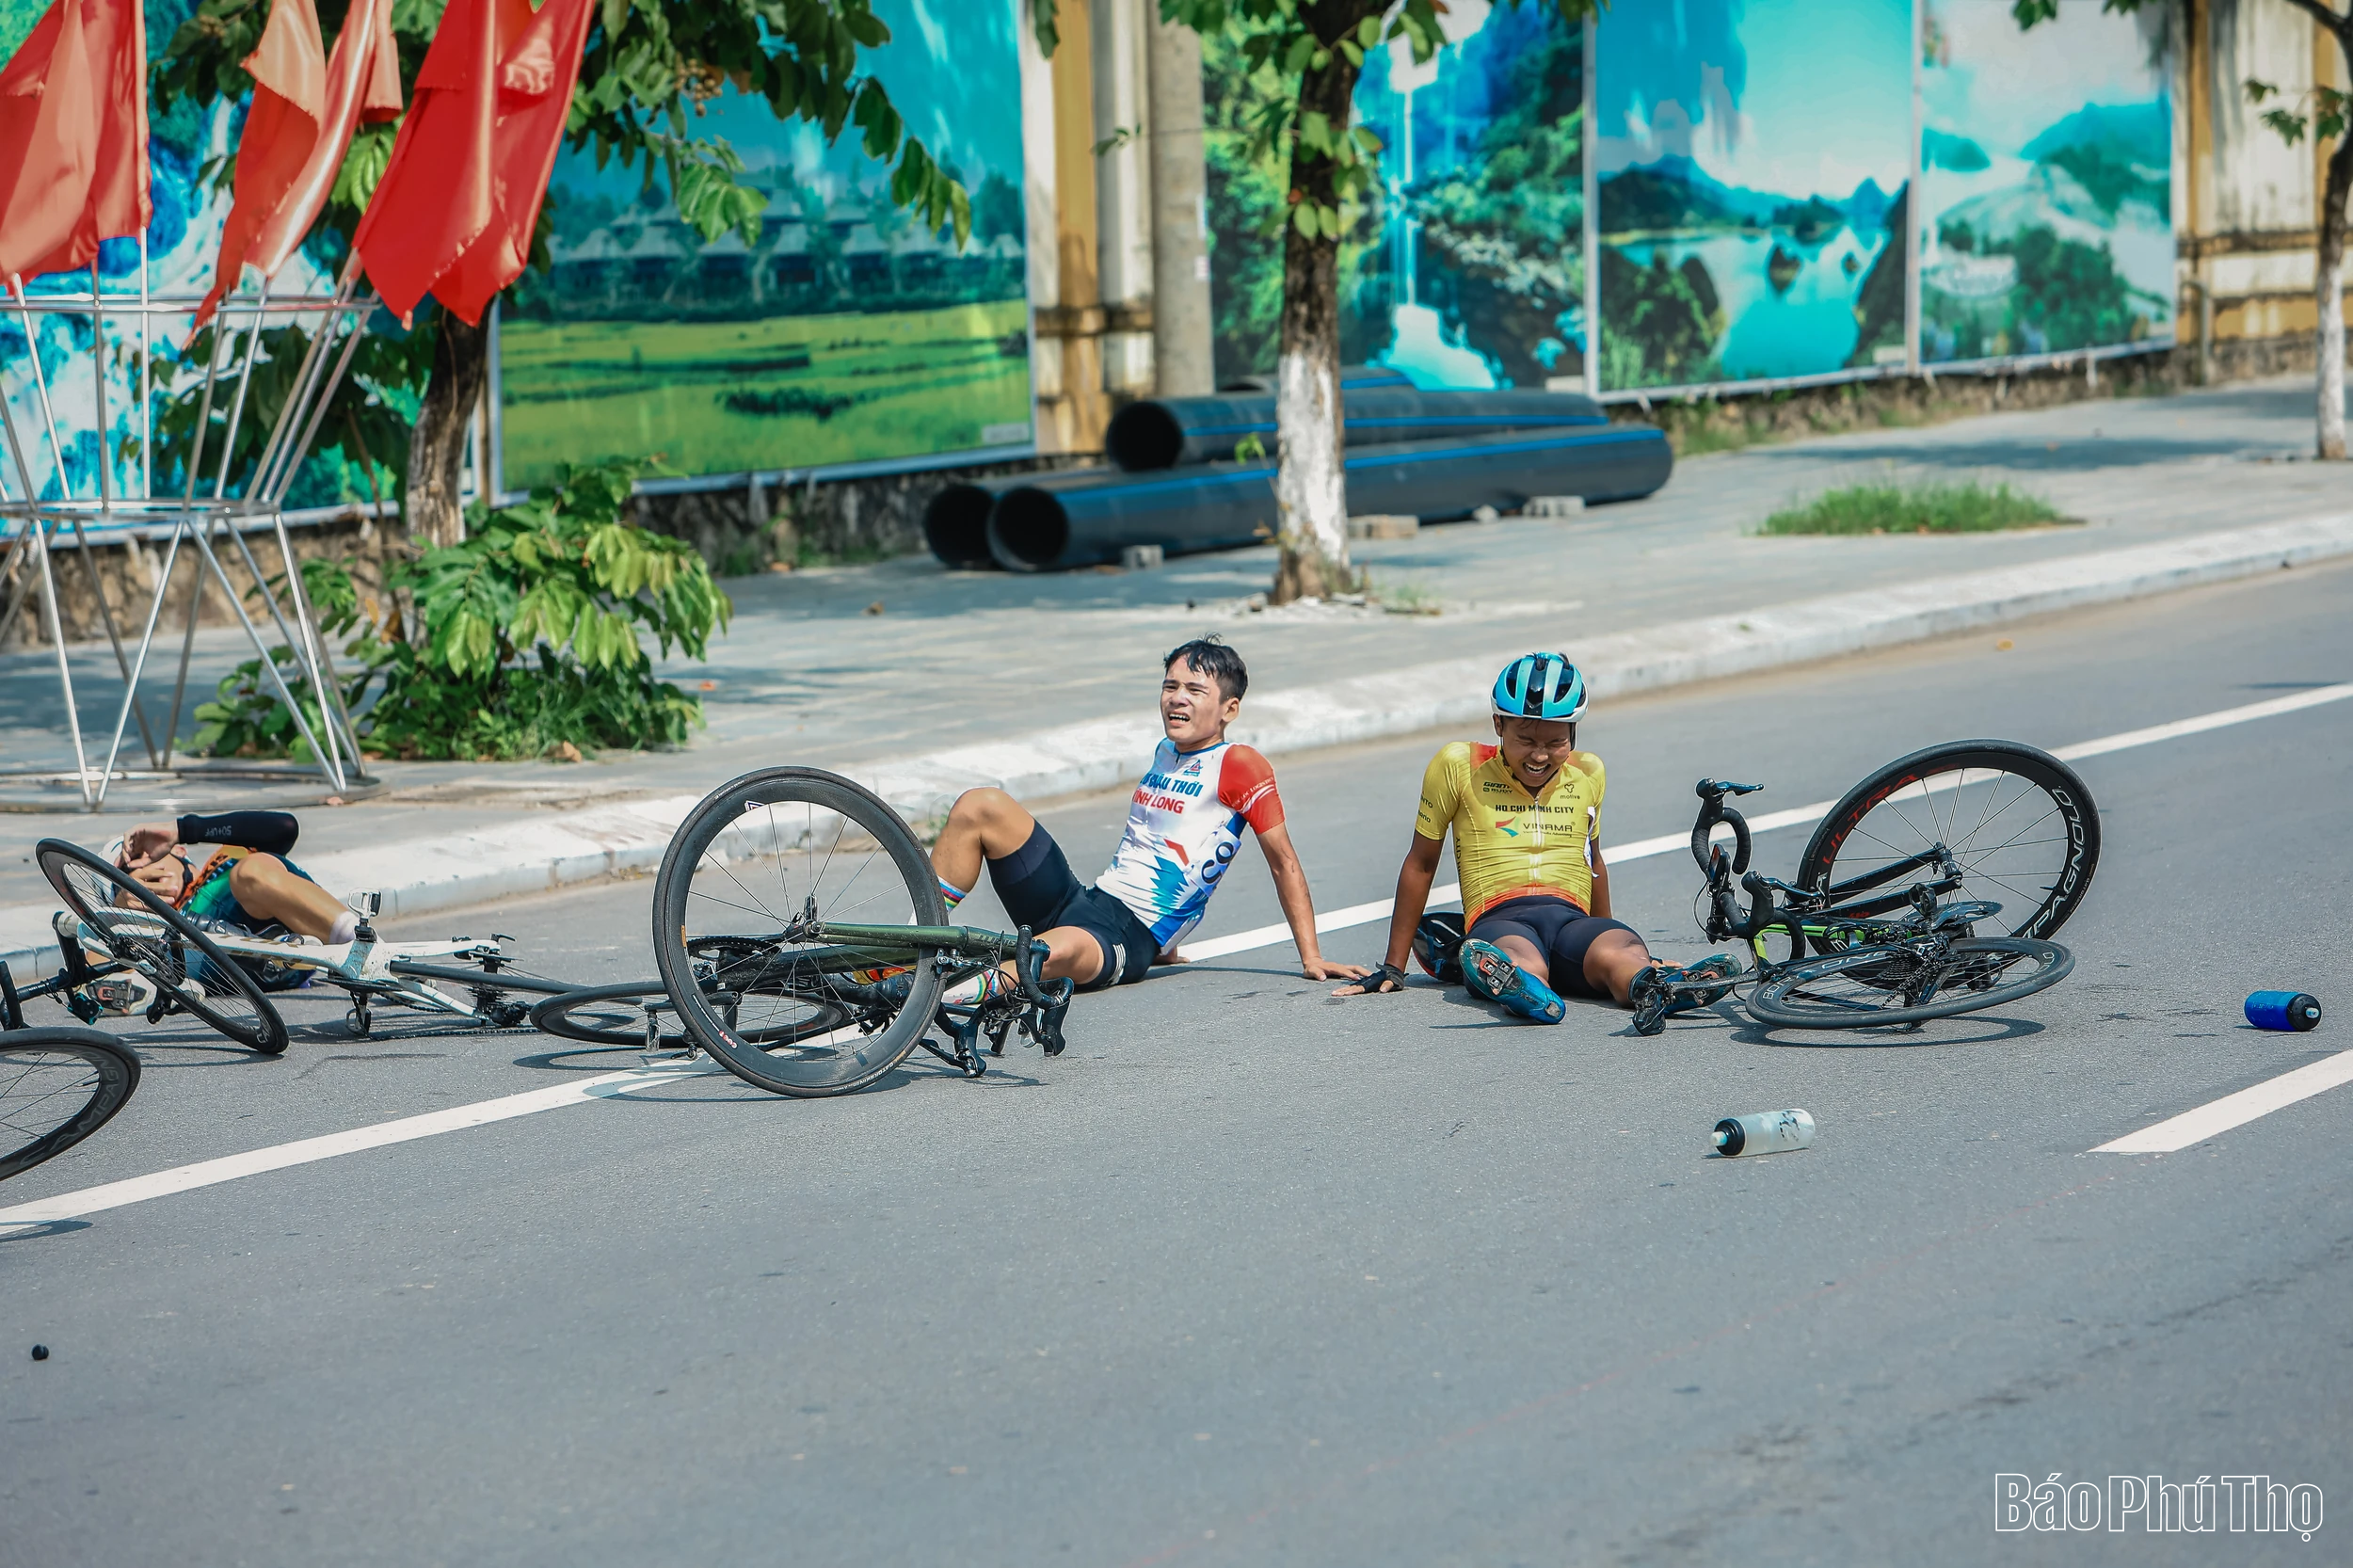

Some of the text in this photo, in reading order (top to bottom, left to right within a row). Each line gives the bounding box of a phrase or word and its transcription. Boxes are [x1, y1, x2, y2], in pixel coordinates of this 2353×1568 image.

[1150, 794, 1185, 814] LONG
[1523, 823, 1573, 832] VINAMA
[1822, 773, 1919, 865] ULTRA
